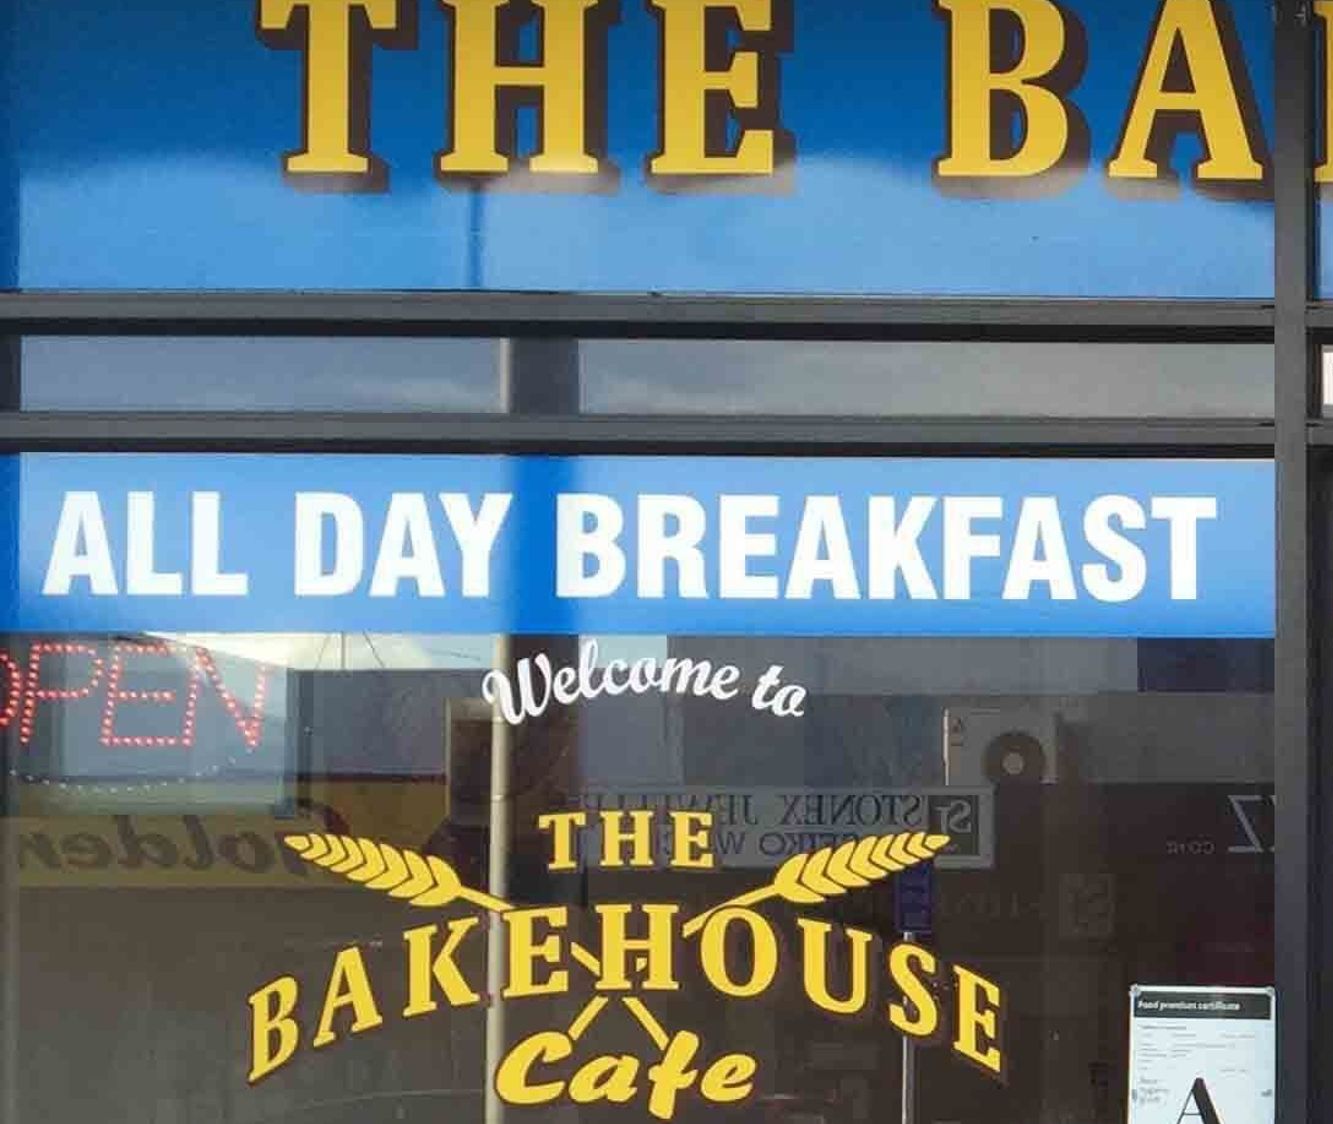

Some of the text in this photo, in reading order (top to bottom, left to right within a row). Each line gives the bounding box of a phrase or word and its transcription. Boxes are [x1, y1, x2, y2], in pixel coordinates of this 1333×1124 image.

[258, 0, 782, 178] THE
[43, 491, 1218, 601] ALL DAY BREAKFAST
[0, 642, 268, 752] PEN
[481, 637, 806, 724] Welcome to
[538, 810, 715, 870] THE
[247, 903, 1004, 1082] BAKEHOUSE
[495, 1030, 757, 1118] Cafe
